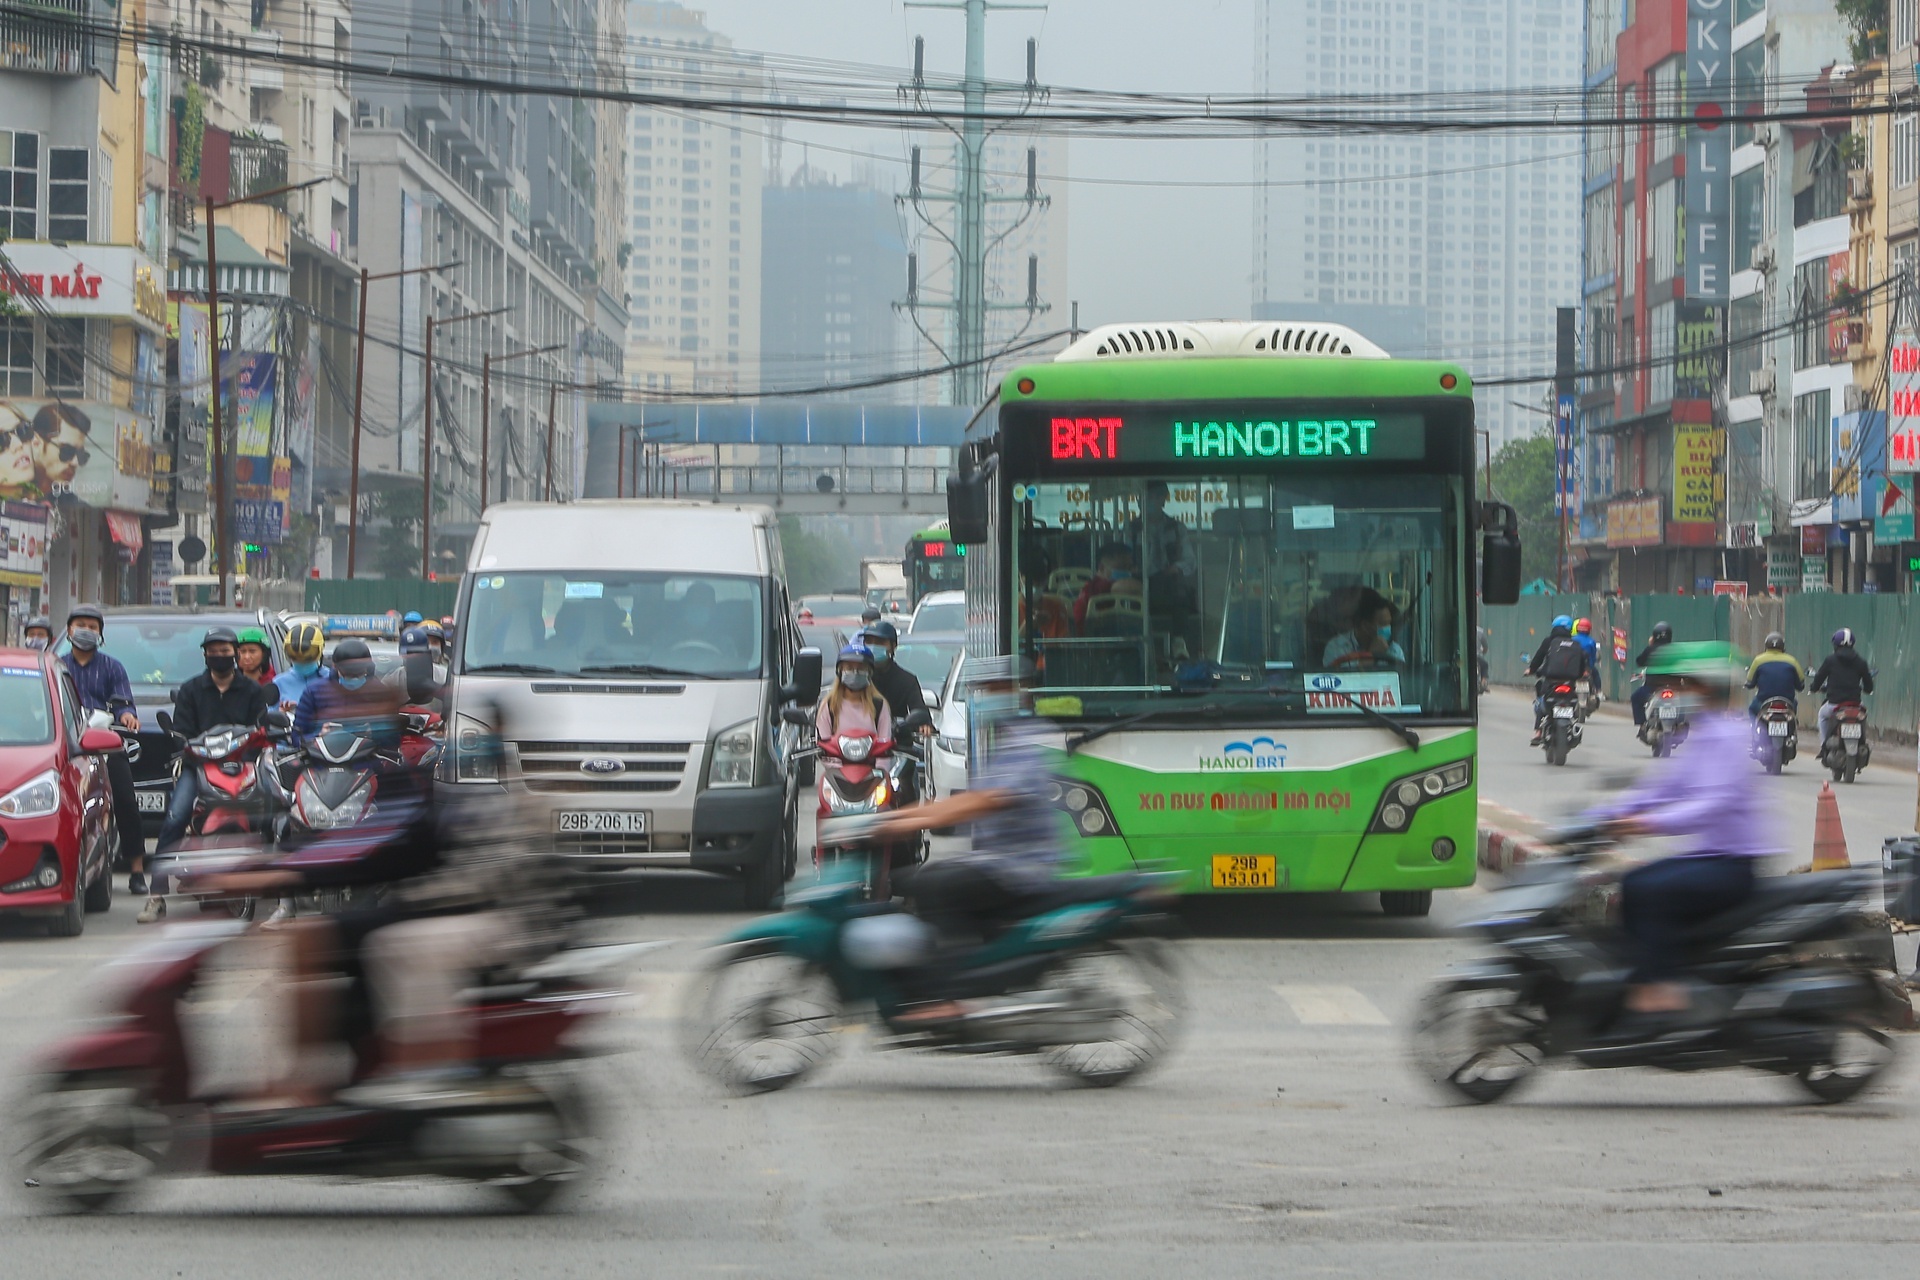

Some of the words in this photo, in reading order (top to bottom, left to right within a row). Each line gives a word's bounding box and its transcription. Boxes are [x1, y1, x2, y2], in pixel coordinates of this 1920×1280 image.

[1699, 142, 1717, 294] LIFE
[51, 262, 103, 298] MẮT
[1893, 342, 1920, 373] RĂN
[1051, 417, 1123, 459] BRT
[1174, 421, 1290, 457] HANOI
[1298, 419, 1376, 456] BRT
[1686, 478, 1712, 490] CÁ
[1308, 692, 1353, 709] KIM
[1360, 685, 1396, 708] MÃ
[1170, 792, 1205, 811] BUS
[1210, 792, 1278, 811] NHANH
[1283, 787, 1310, 811] HÀ
[1314, 787, 1351, 815] NỘI
[1231, 855, 1258, 871] 29B
[1221, 871, 1267, 887] 153.01
